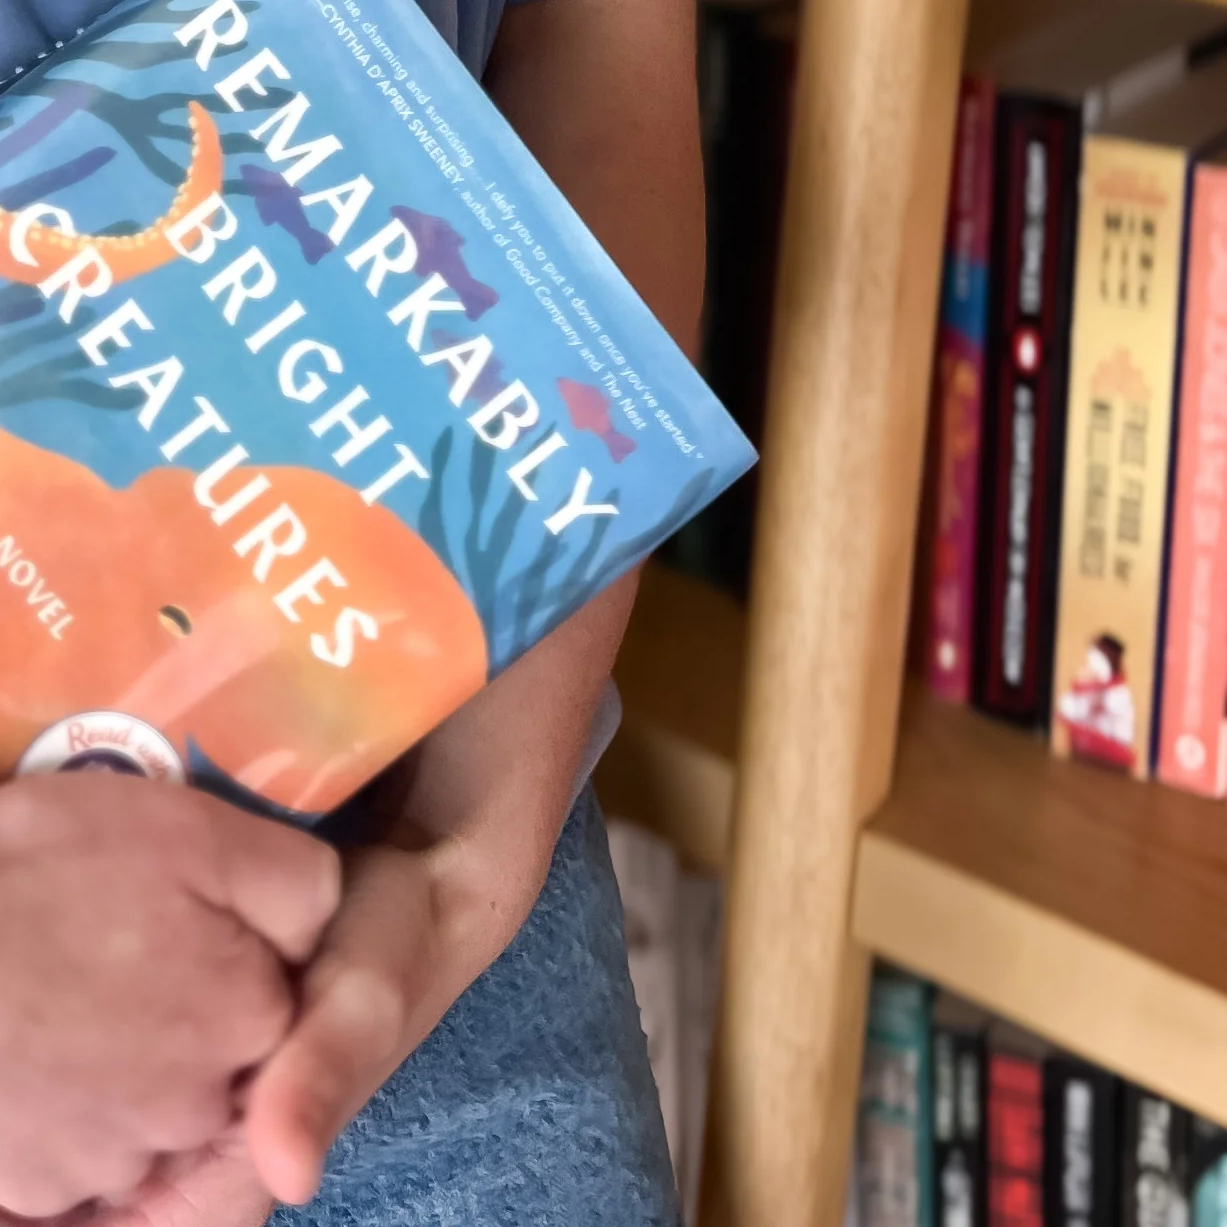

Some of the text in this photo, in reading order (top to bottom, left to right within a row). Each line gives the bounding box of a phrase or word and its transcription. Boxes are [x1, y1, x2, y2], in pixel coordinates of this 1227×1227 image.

[359, 20, 410, 81] charming
[404, 78, 431, 105] and
[8, 202, 379, 668] CREATURES
[166, 191, 429, 507] BRIGHT
